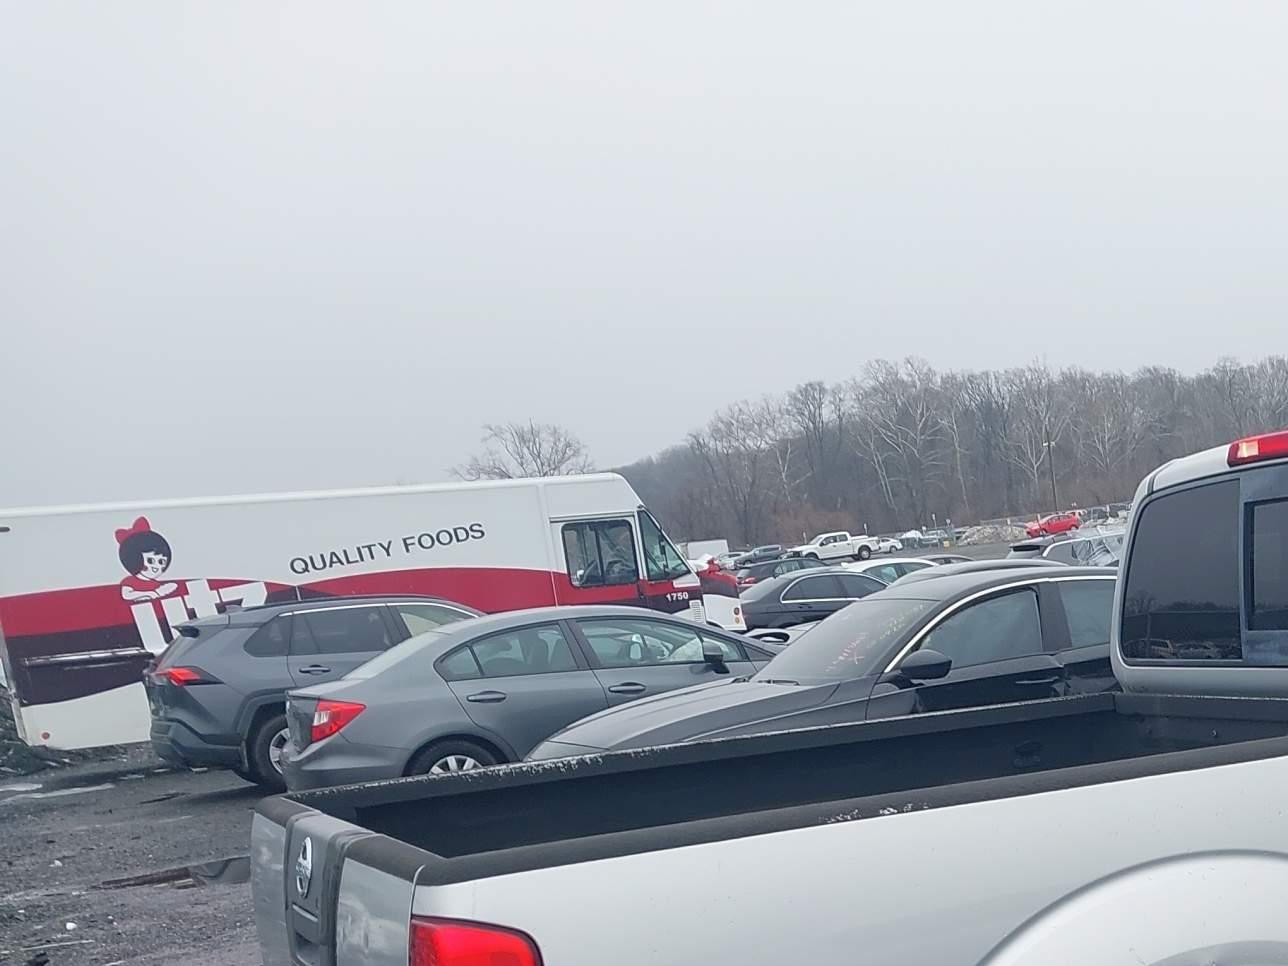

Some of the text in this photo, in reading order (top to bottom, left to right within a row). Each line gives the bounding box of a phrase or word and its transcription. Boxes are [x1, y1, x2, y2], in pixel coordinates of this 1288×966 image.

[289, 523, 486, 575] QUALITY FOODS
[665, 591, 689, 602] 1750
